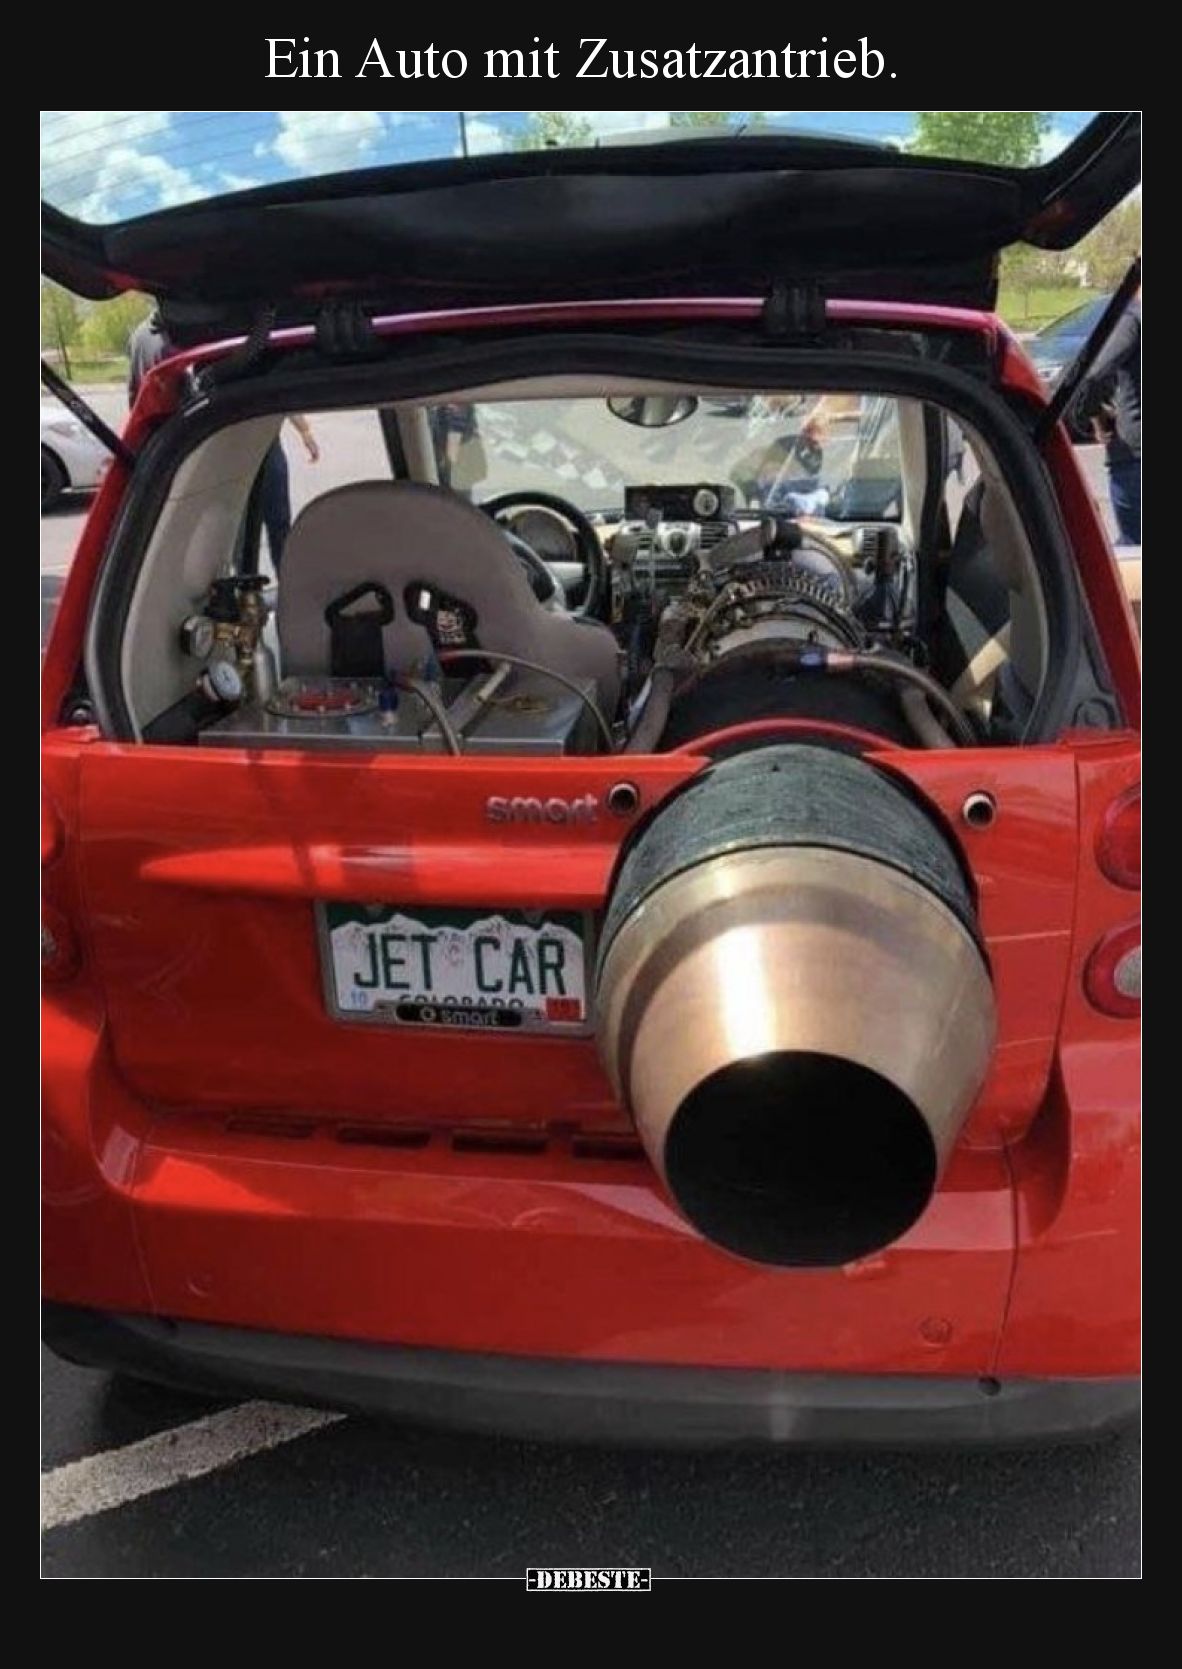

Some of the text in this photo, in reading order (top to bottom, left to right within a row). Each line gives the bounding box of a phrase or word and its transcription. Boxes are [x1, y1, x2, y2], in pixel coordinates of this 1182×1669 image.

[487, 793, 598, 823] smart
[353, 933, 566, 995] JET CAR
